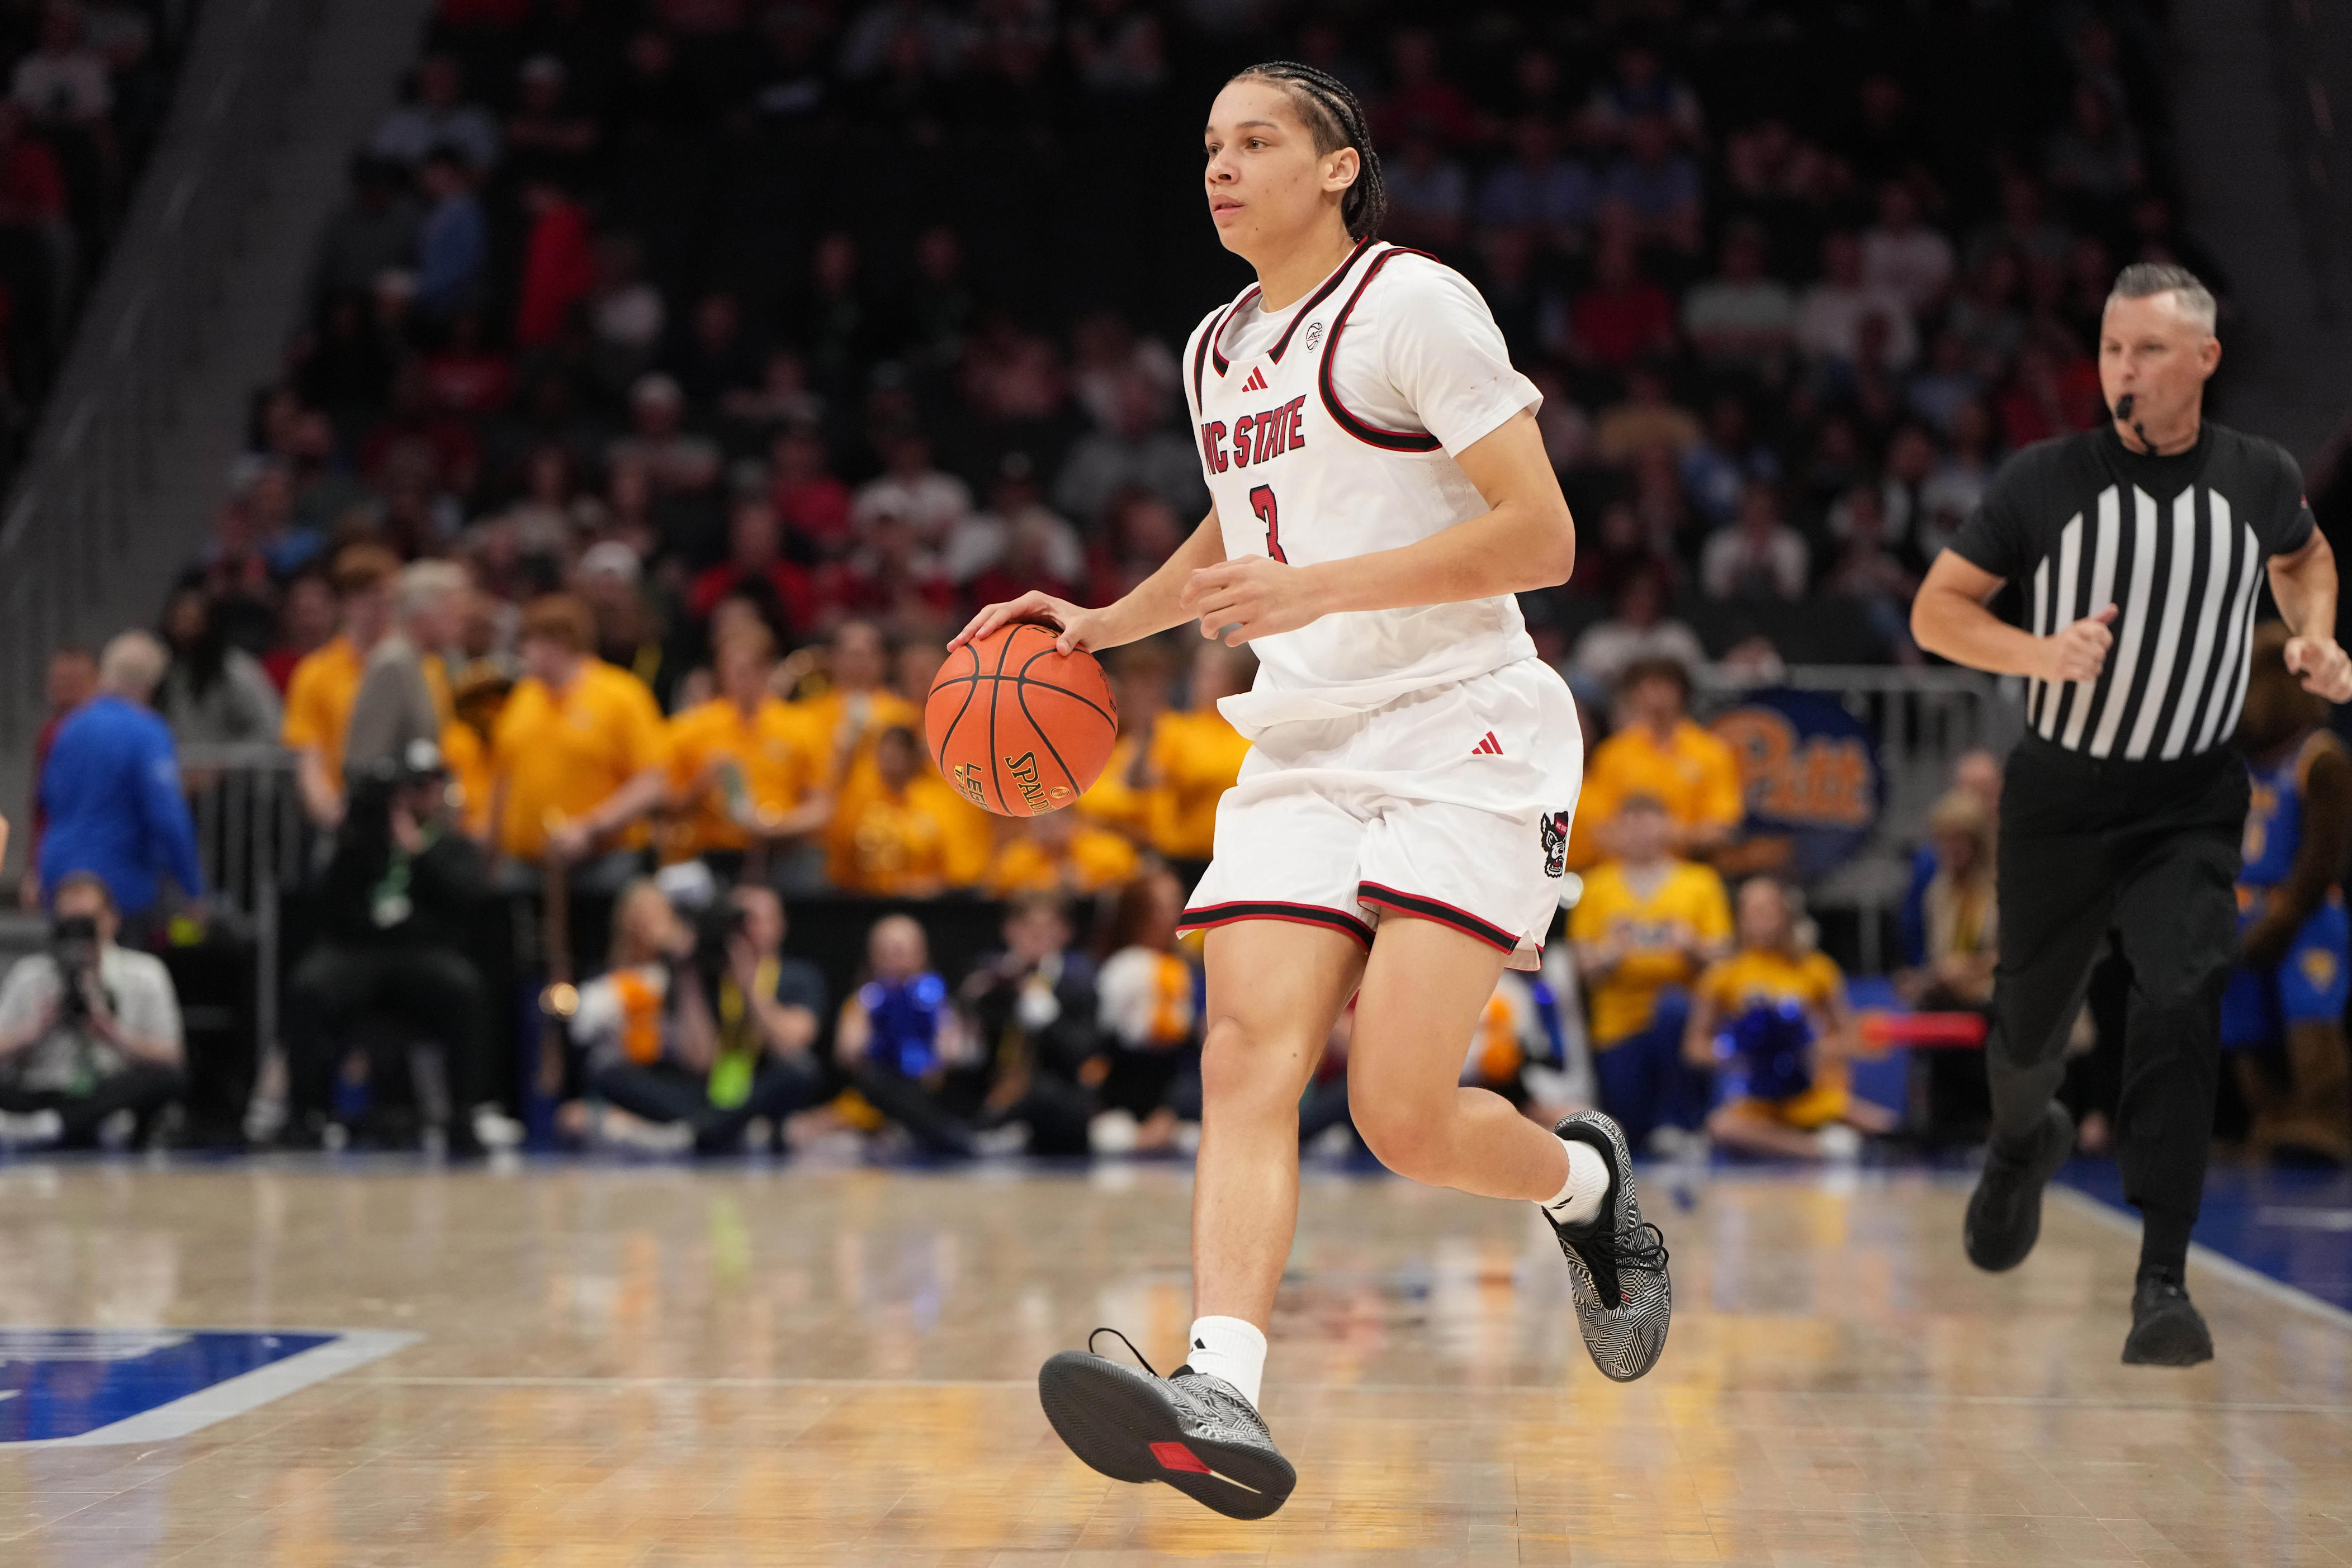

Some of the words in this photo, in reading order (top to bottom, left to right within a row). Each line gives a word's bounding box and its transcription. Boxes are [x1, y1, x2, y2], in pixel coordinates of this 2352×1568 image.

[1308, 330, 1322, 339] ACC
[1201, 420, 1228, 475] NC
[1233, 394, 1307, 468] STATE
[1250, 484, 1289, 565] 3
[1004, 751, 1056, 815] SPALDI
